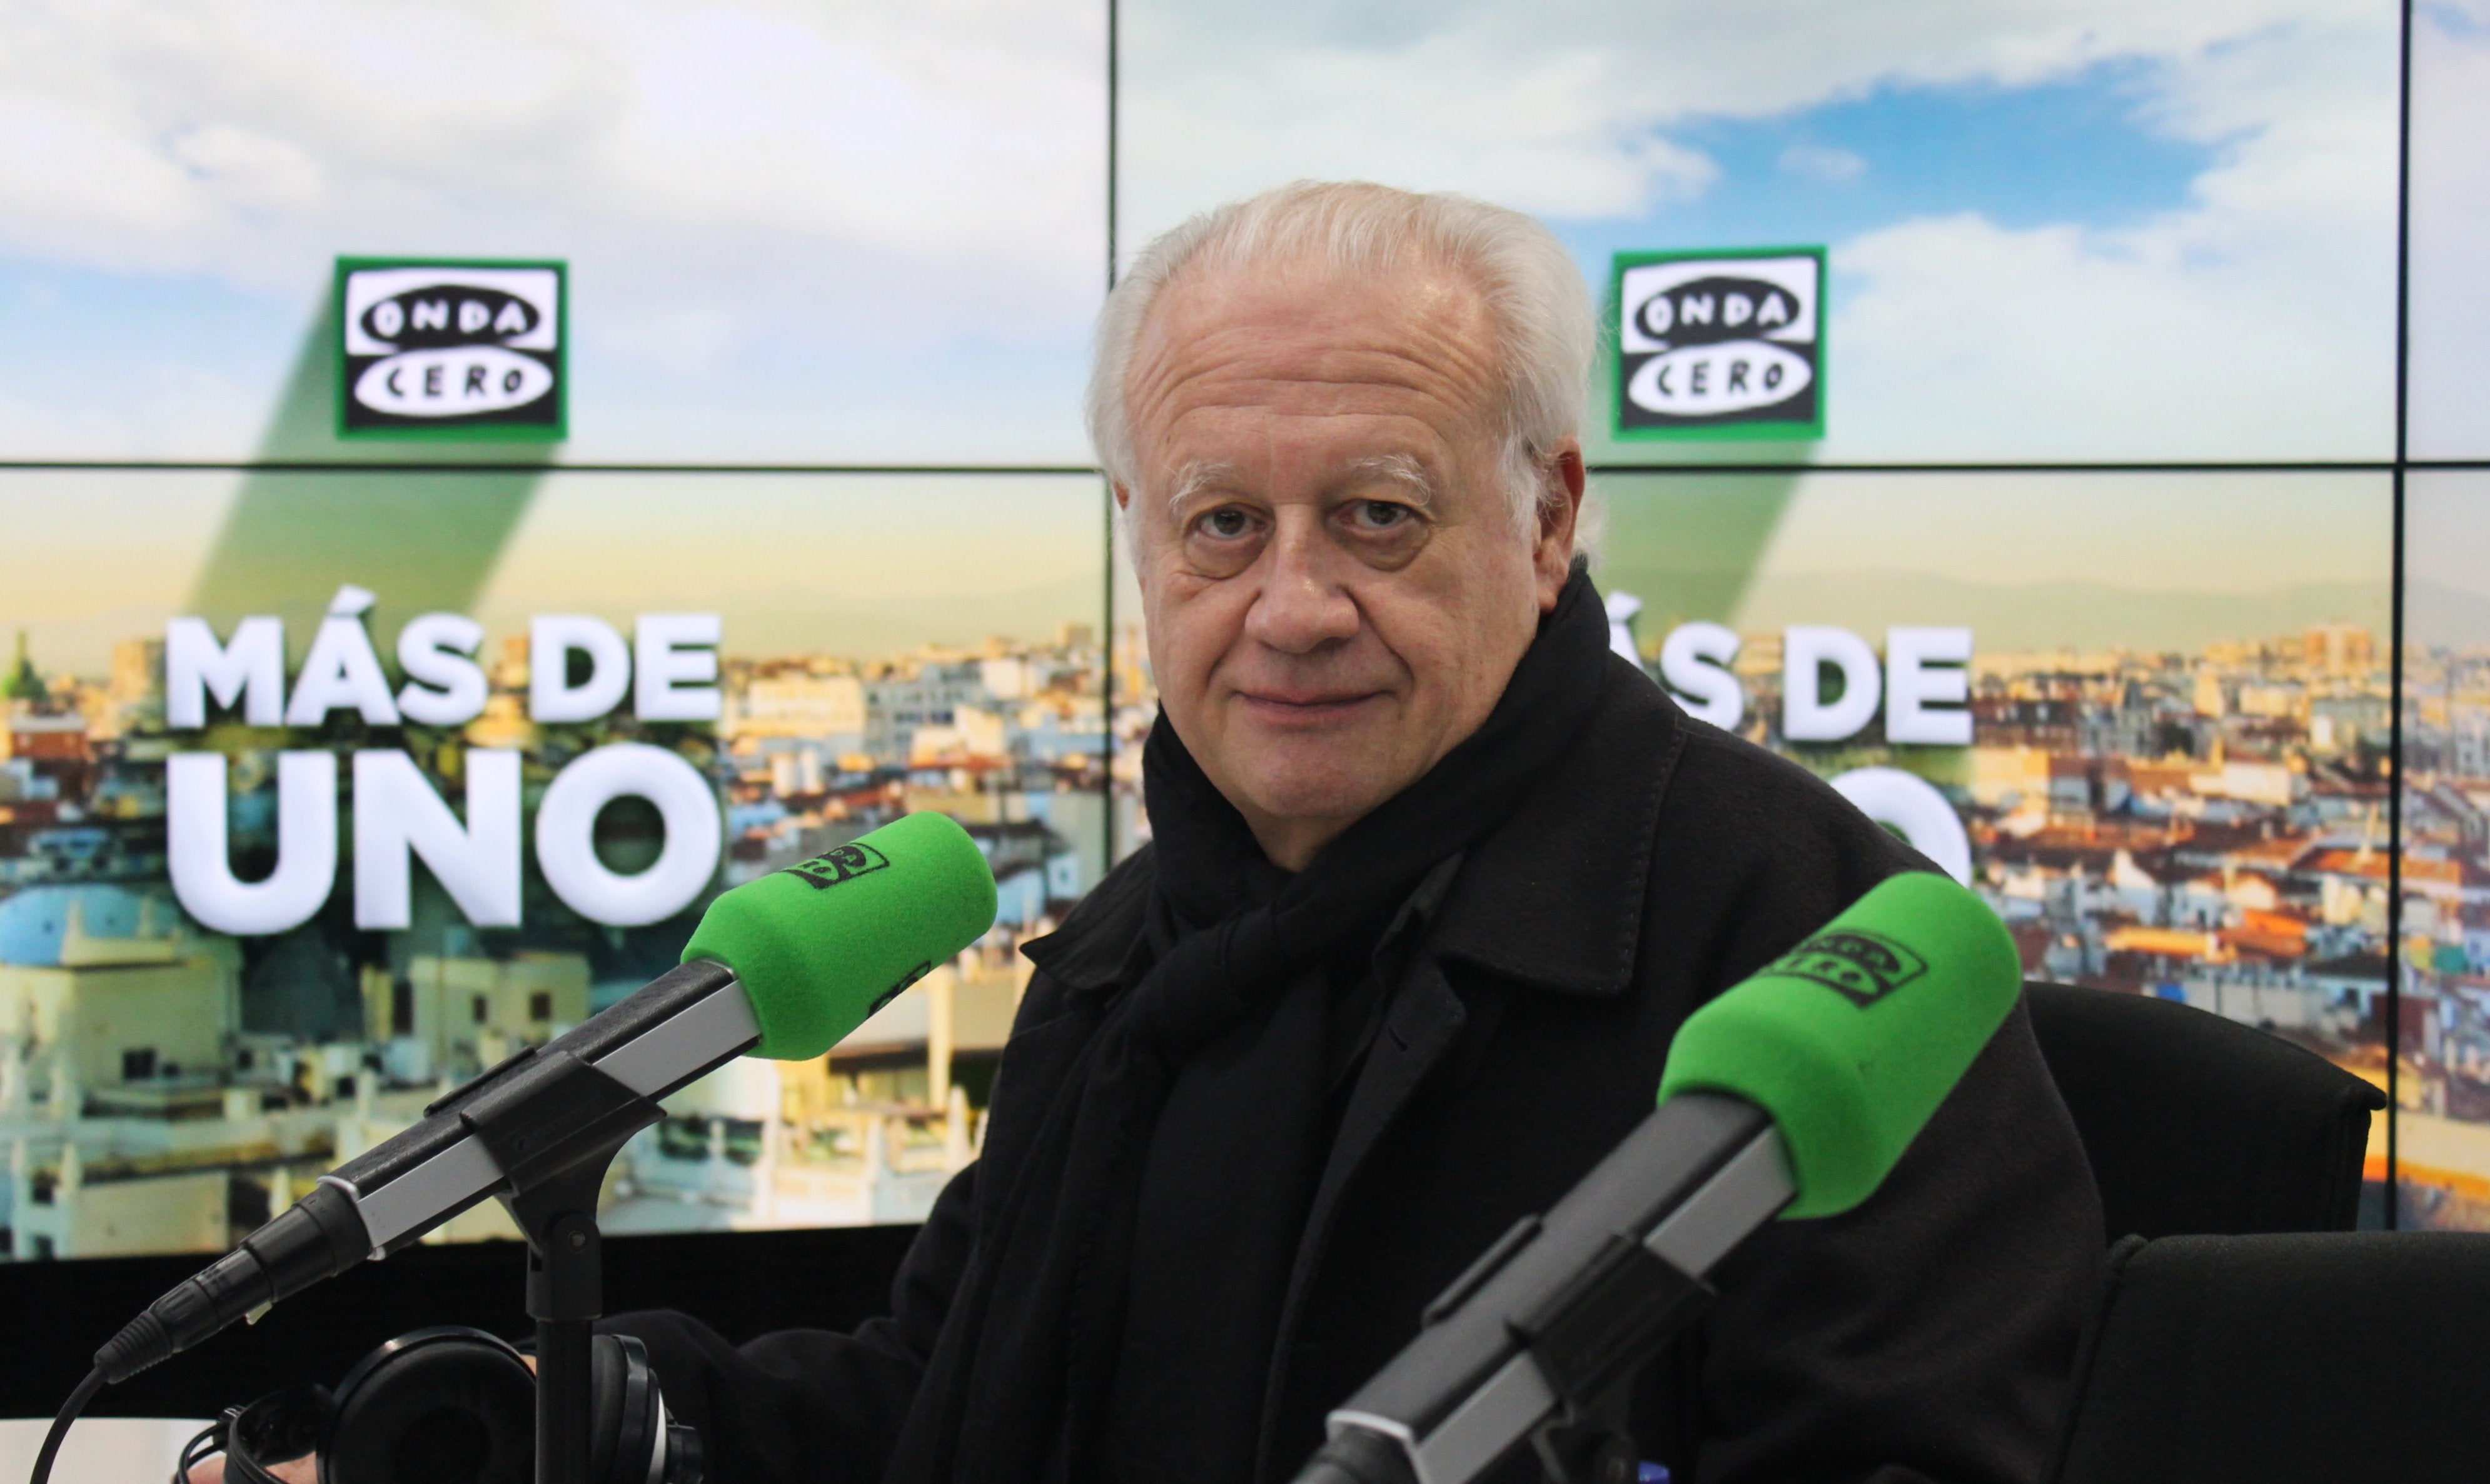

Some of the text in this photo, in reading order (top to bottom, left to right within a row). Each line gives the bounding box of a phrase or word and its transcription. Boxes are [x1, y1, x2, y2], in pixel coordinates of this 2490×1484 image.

[371, 298, 529, 338] ONDA
[1644, 290, 1788, 335] ONDA
[386, 364, 523, 397] CERO
[1656, 359, 1784, 396] CERO
[166, 584, 722, 728] MÁS DE
[1782, 625, 1973, 744] DE
[166, 741, 722, 935] UNO
